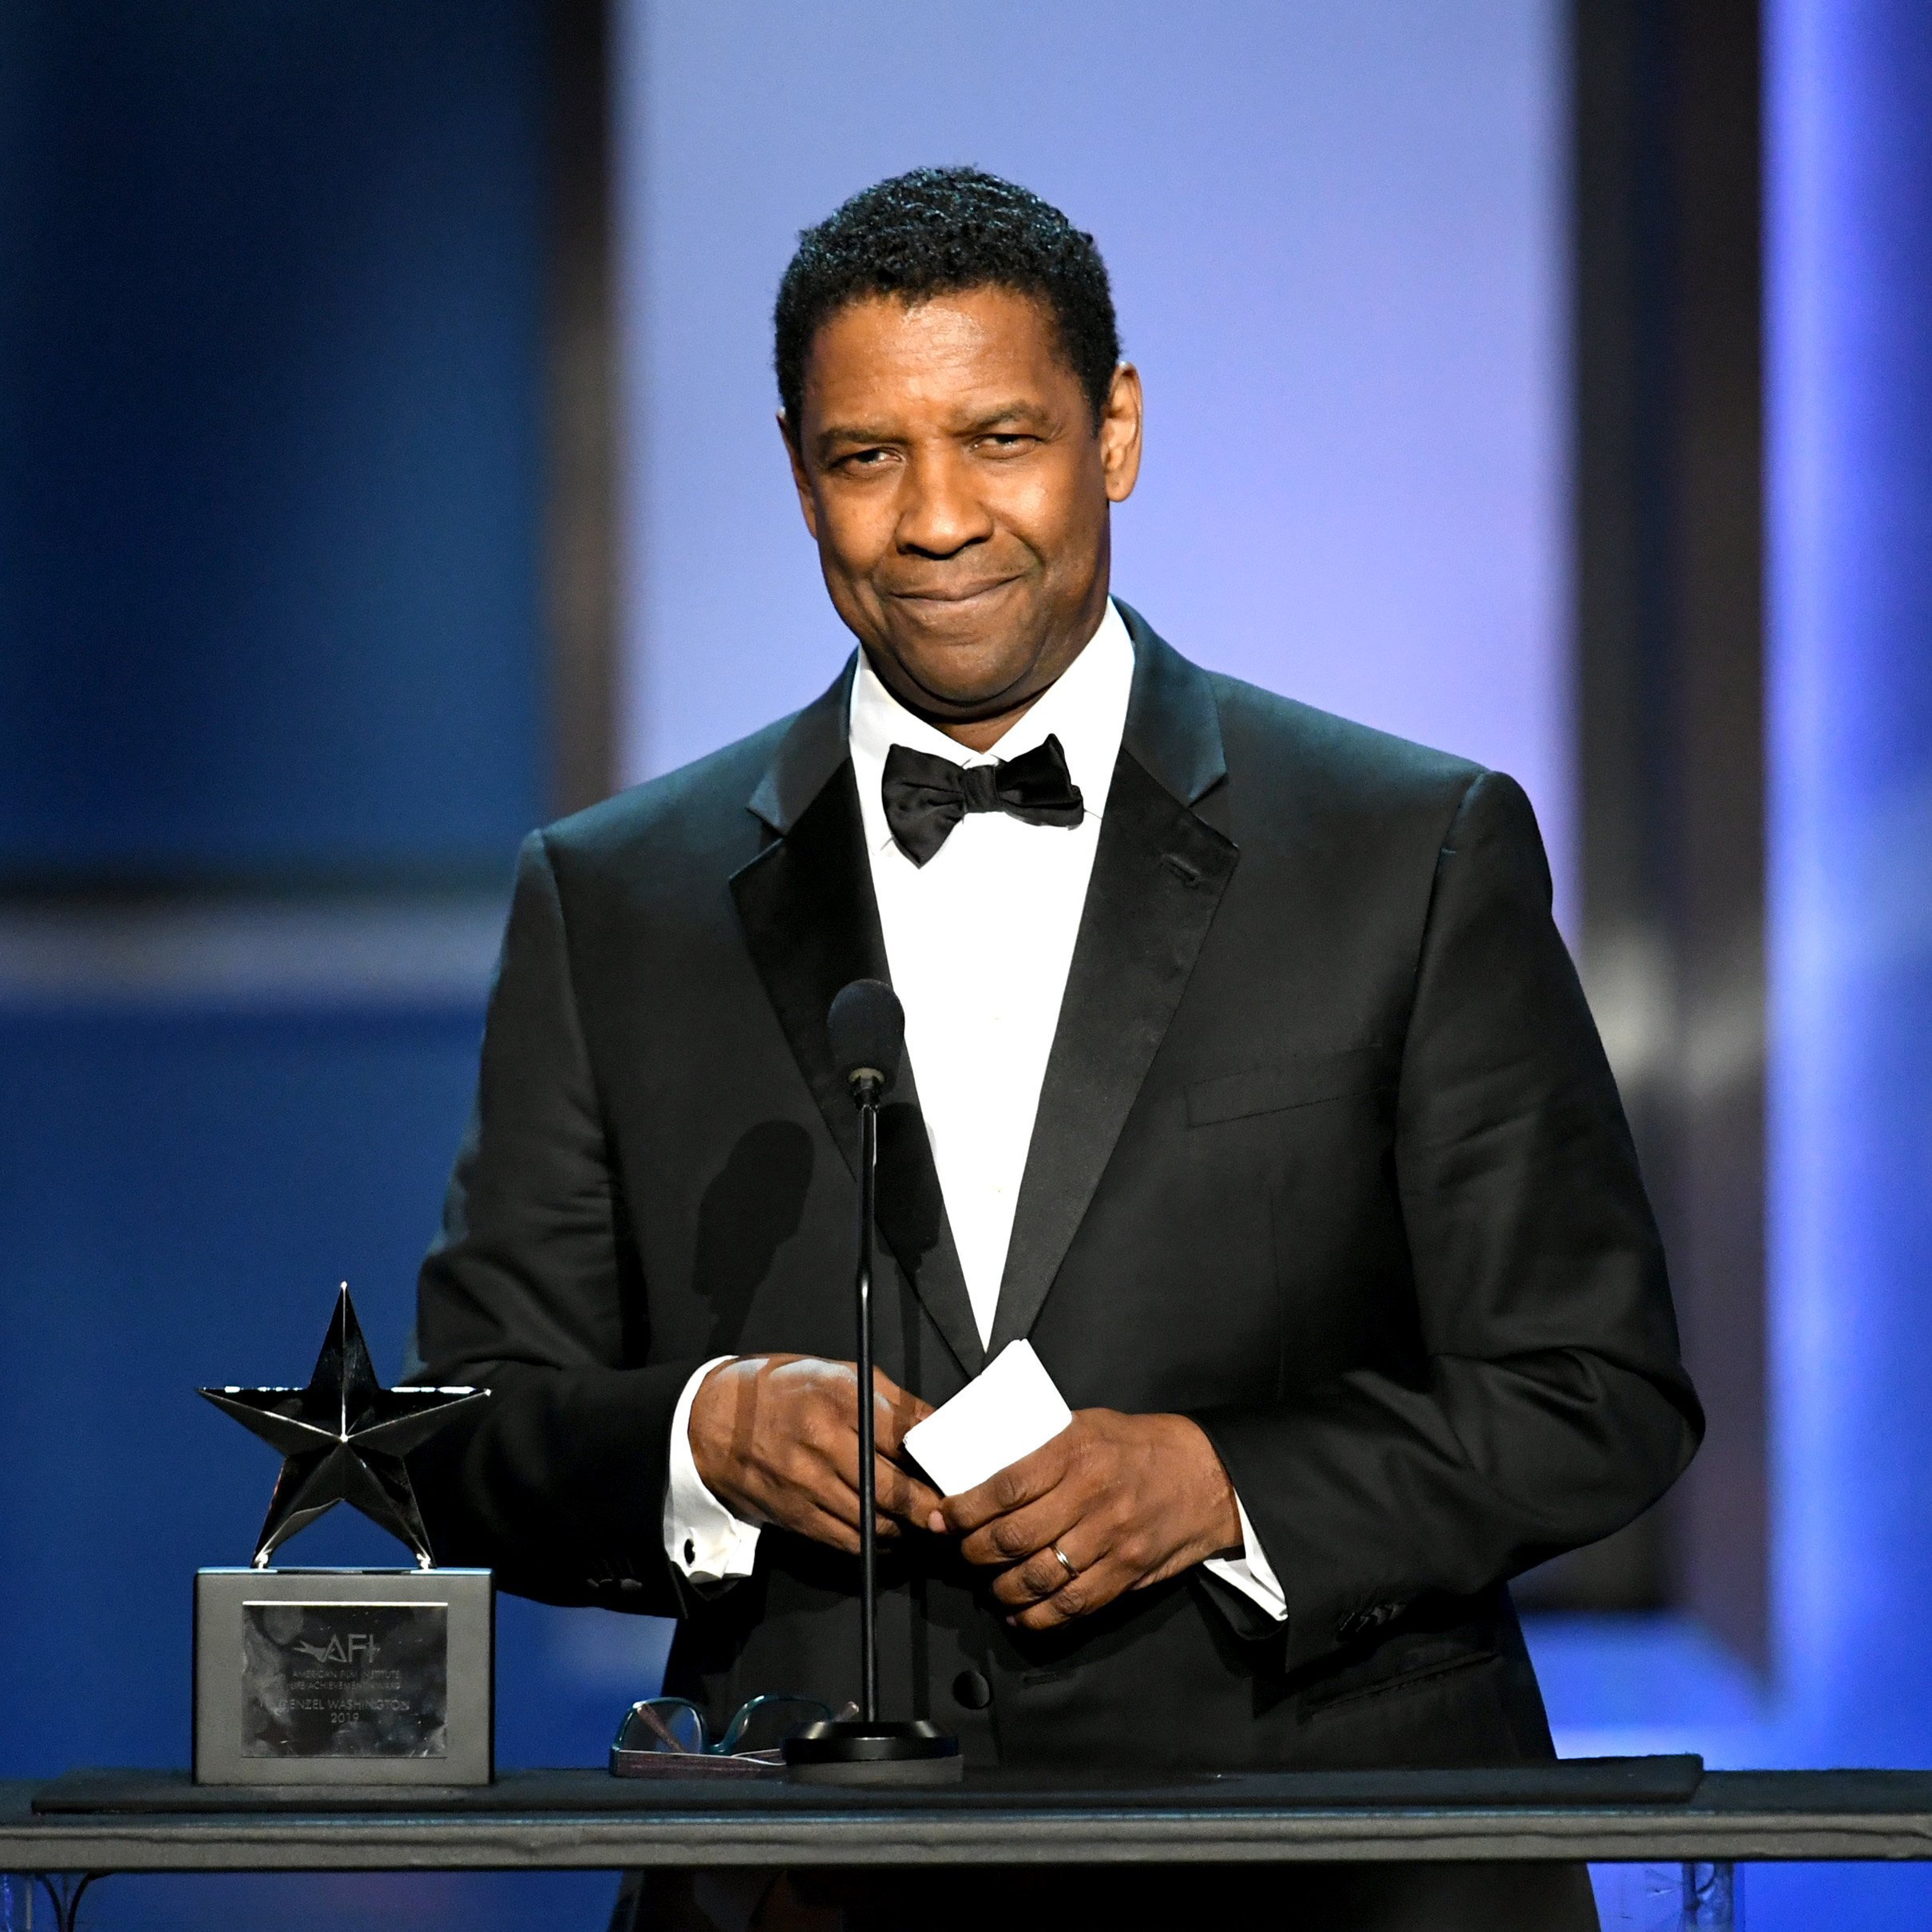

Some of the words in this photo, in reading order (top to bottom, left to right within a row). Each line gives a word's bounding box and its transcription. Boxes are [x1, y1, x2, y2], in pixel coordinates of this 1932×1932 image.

[318, 1633, 377, 1663] AFI
[292, 1669, 337, 1678] AMERICAN
[359, 1669, 400, 1678] NSTITUTE
[279, 1699, 324, 1710] DENZEL
[327, 1699, 410, 1711] WASHINGTON
[331, 1712, 359, 1724] 2019
